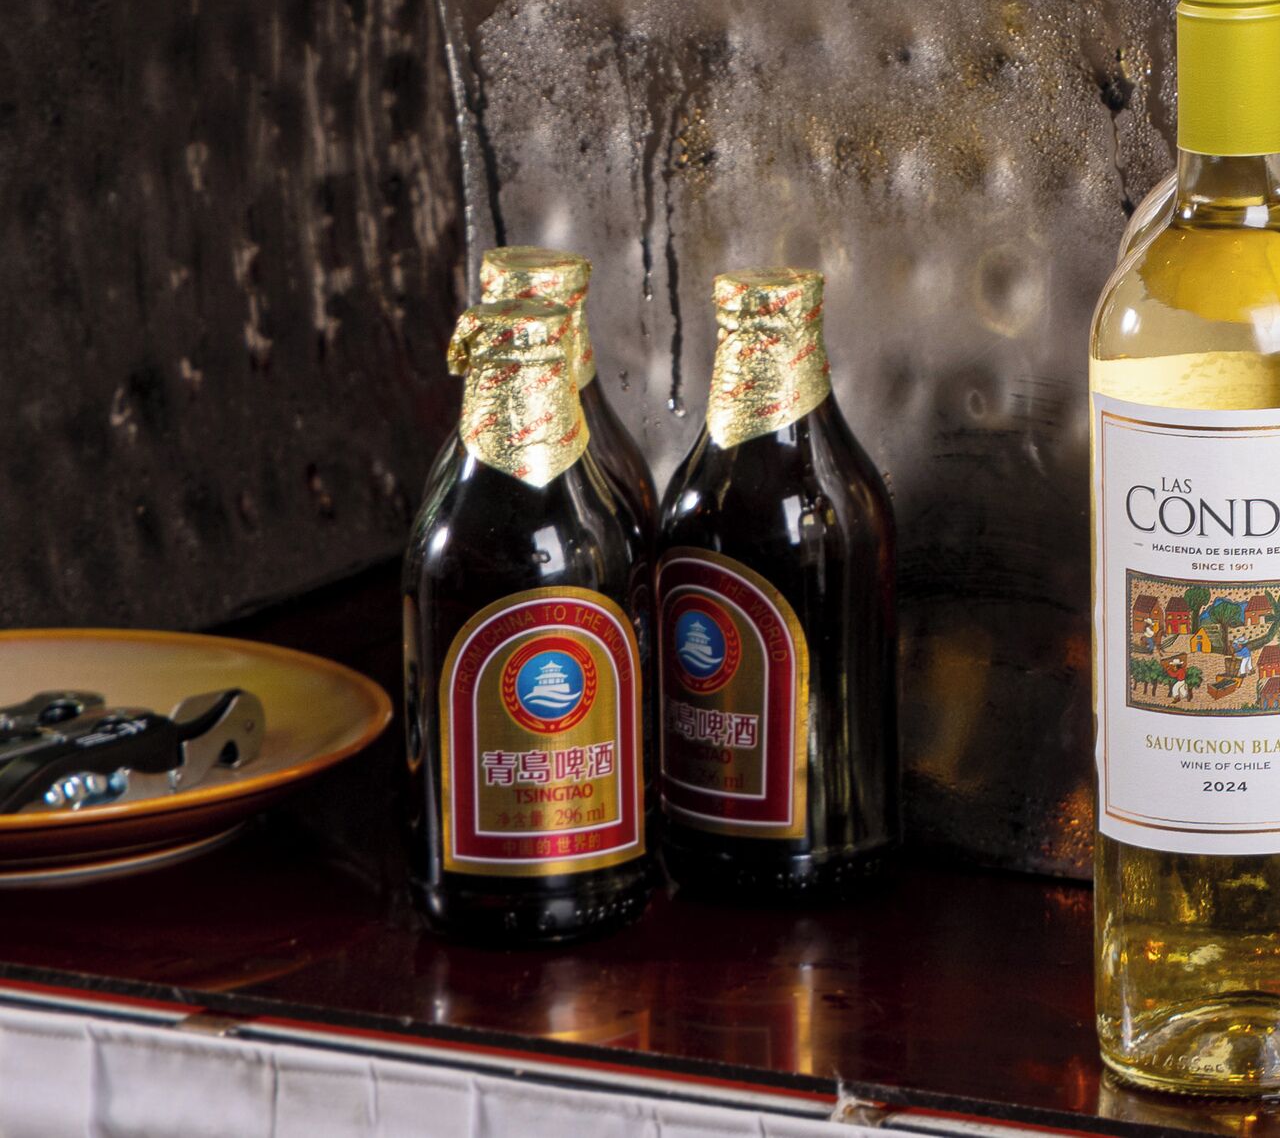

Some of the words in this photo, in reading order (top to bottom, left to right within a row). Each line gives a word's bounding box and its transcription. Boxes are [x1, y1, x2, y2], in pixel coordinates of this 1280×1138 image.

[1162, 477, 1192, 494] LAS
[1152, 543, 1202, 556] HACIENDA
[1205, 547, 1220, 556] DE
[1223, 547, 1263, 556] SIERRA
[1191, 562, 1225, 572] SINCE
[1229, 562, 1254, 571] 1901
[483, 611, 535, 651] CHINA
[543, 604, 567, 622] TO
[574, 605, 606, 631] THE
[603, 628, 631, 682] WORLD
[1145, 733, 1245, 755] SAUVIGNON
[1180, 760, 1212, 771] WINE
[1214, 762, 1231, 771] OF
[1233, 761, 1271, 771] CHILE
[512, 783, 594, 805] TSINGTAO
[1202, 781, 1248, 793] 2024
[555, 807, 582, 827] 296
[587, 802, 606, 822] ml
